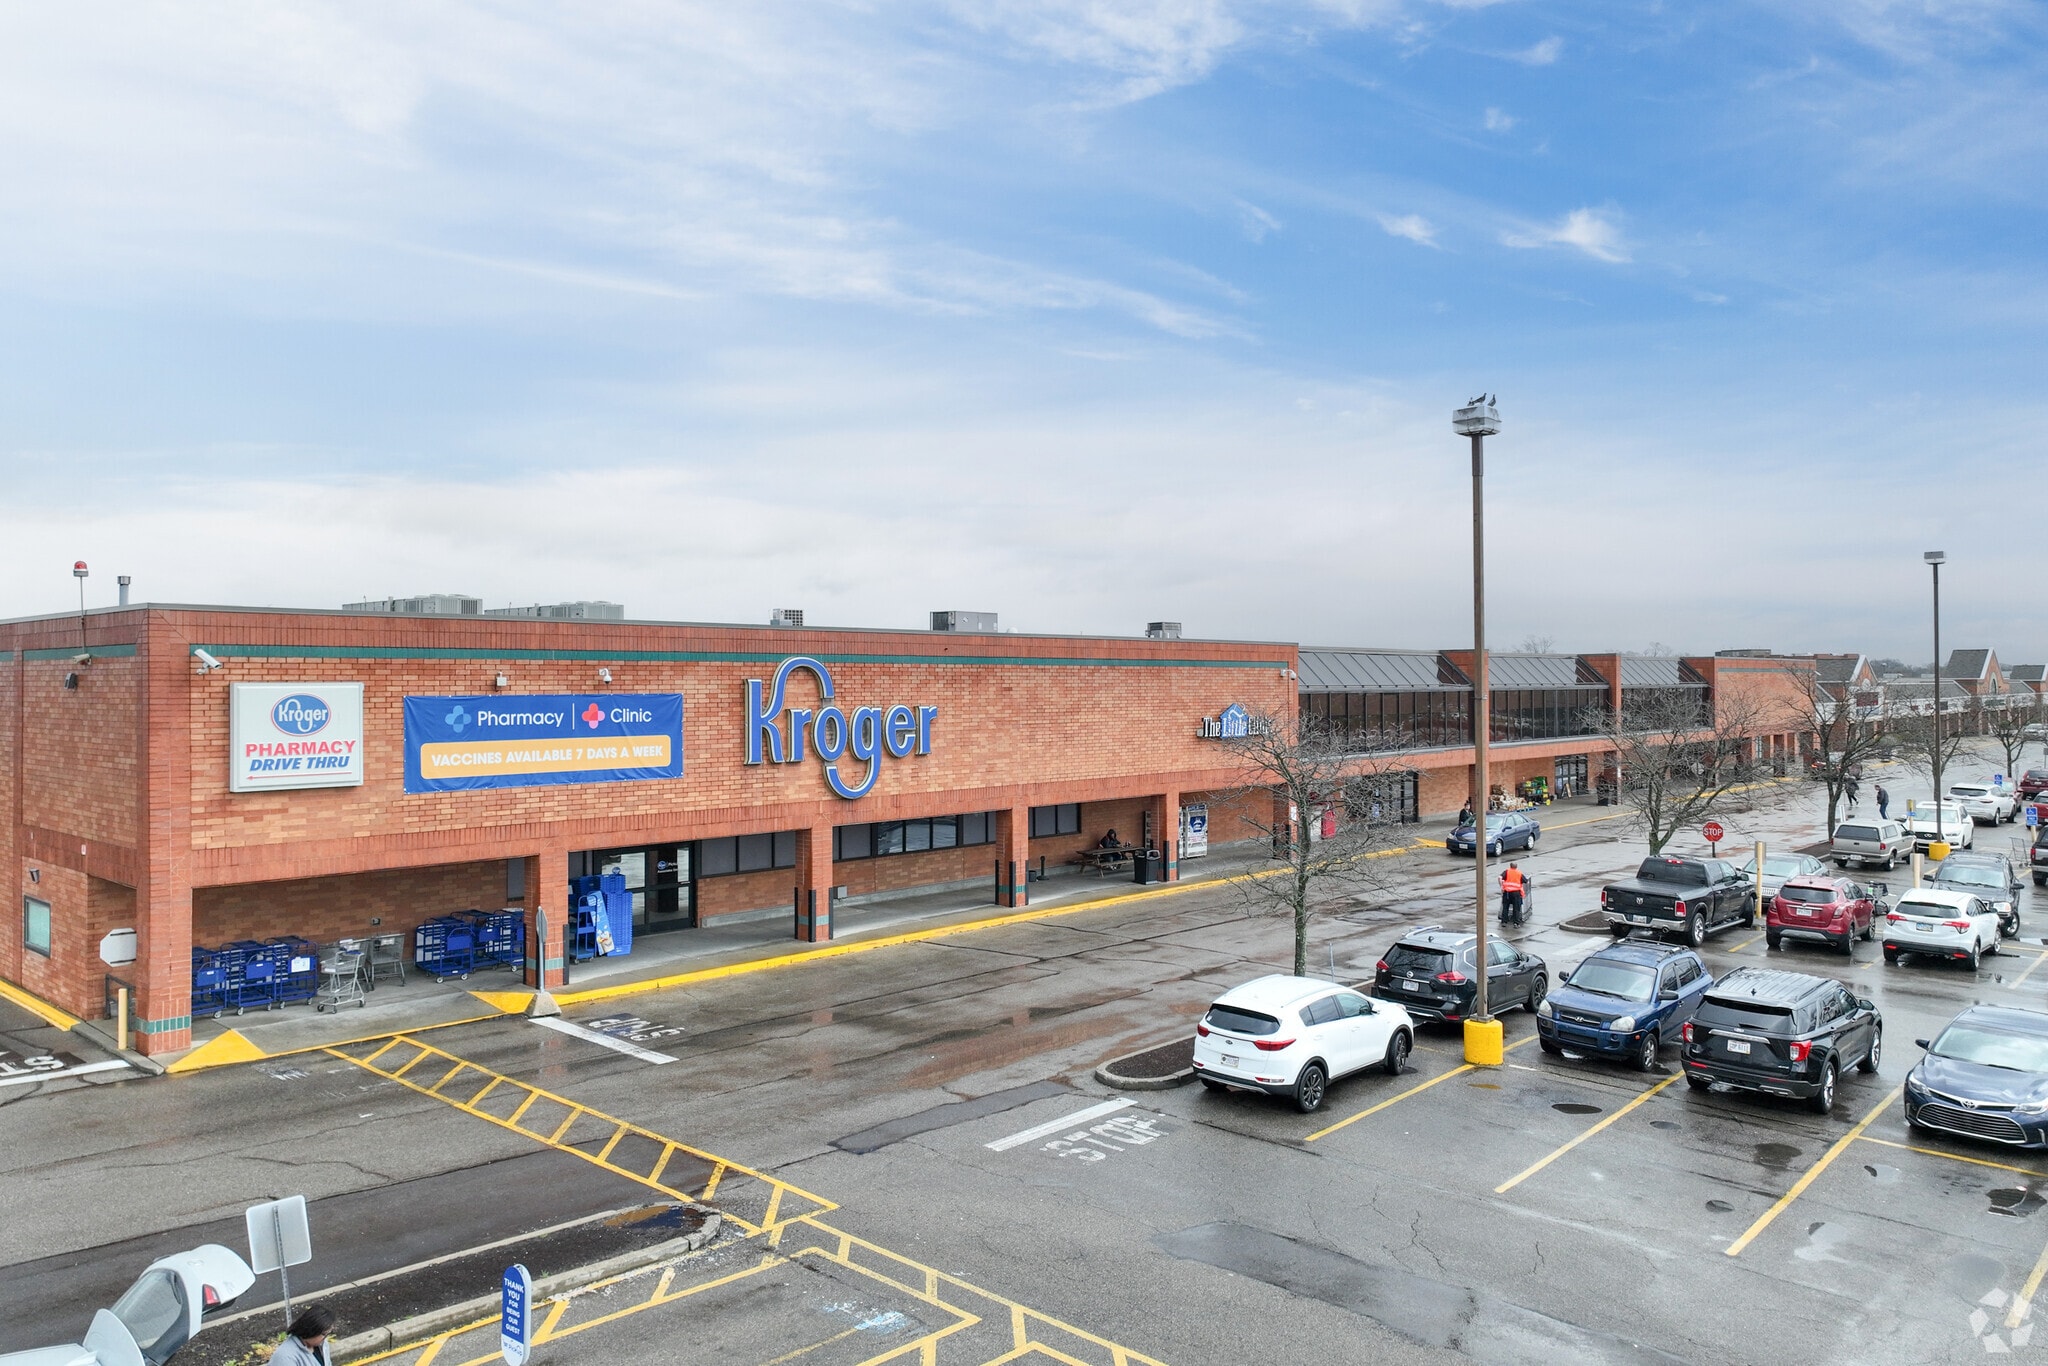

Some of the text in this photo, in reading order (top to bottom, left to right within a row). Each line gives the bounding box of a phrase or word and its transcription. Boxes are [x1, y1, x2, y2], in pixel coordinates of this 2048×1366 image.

[278, 698, 328, 733] Kroger
[477, 707, 652, 728] Pharmacy Clinic
[743, 656, 938, 800] Kroger
[1203, 717, 1221, 737] The
[1222, 717, 1248, 737] Little
[245, 740, 356, 758] PHARMACY
[431, 745, 663, 767] VACCINES AVAILABLE 7 DAYS A WEEK
[249, 755, 350, 772] DRIVE THRU
[1703, 828, 1722, 836] STOP
[504, 1278, 524, 1293] THANK
[507, 1288, 520, 1301] YOU
[506, 1307, 520, 1318] BEING
[508, 1300, 519, 1309] FOR
[505, 1323, 520, 1335] GUEST
[507, 1316, 519, 1326] OUR
